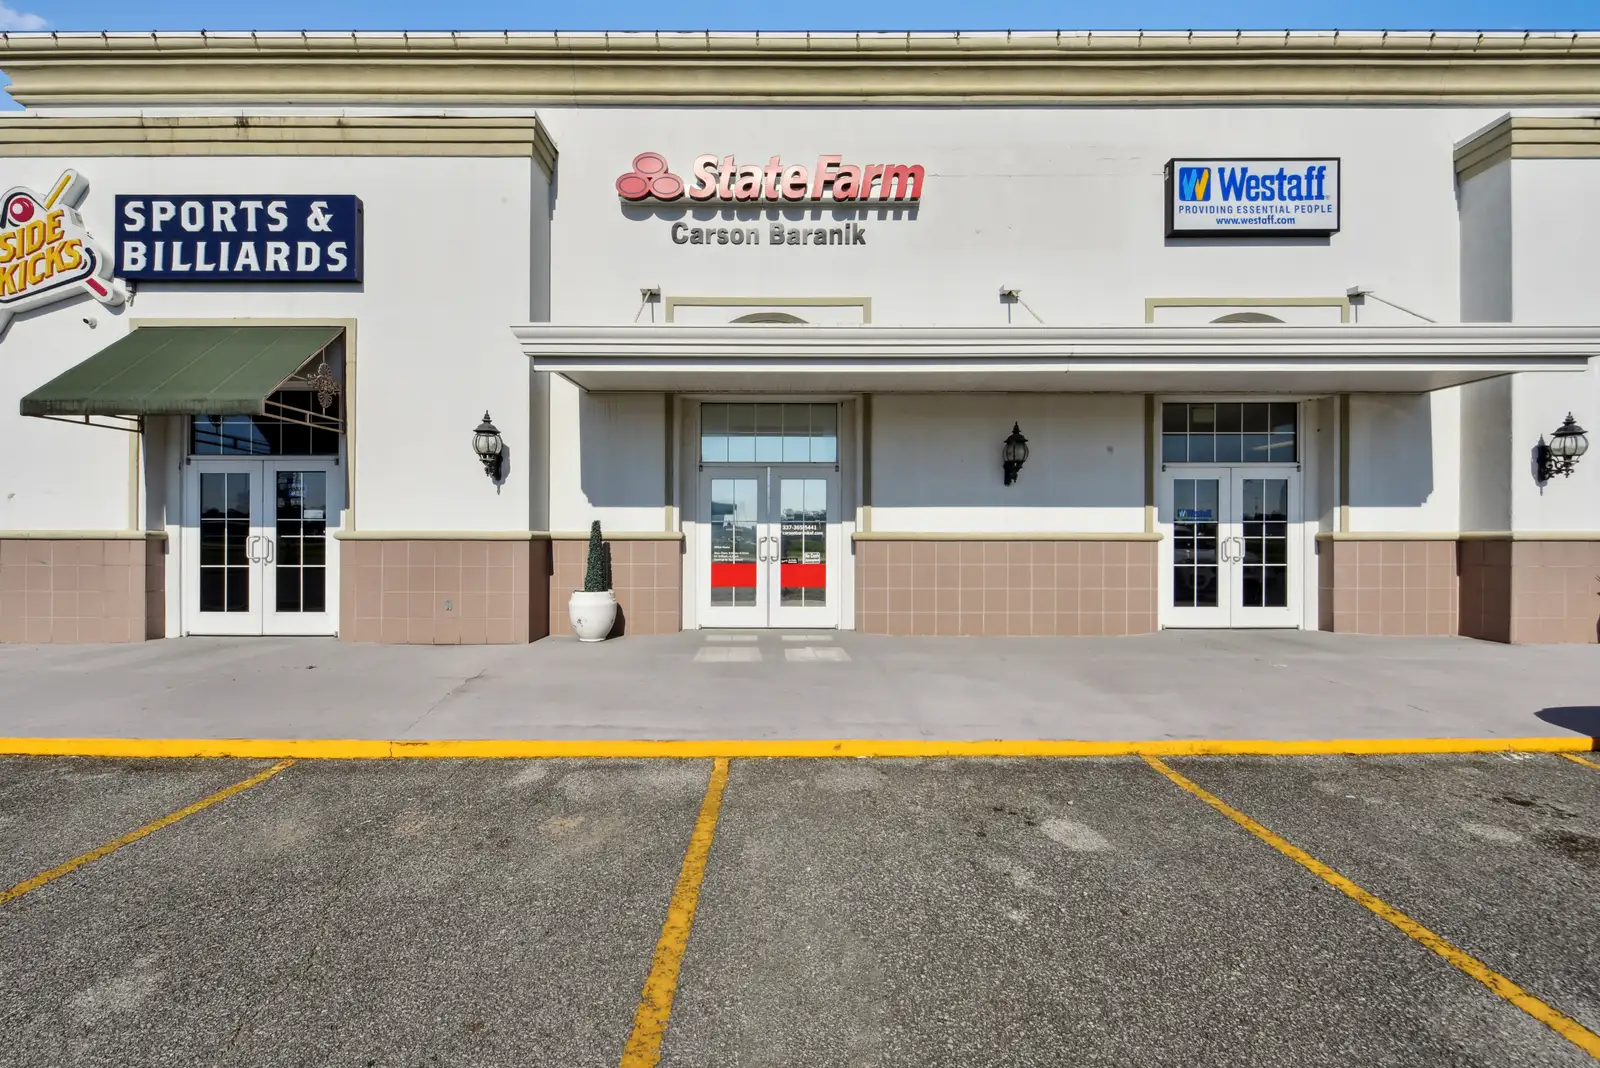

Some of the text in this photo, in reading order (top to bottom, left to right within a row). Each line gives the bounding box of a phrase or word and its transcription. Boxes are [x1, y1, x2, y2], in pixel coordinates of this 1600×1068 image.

[1217, 165, 1327, 202] Westaff
[123, 200, 333, 233] SPORTS &
[1178, 204, 1333, 214] PROVIDING ESSENTIAL PEOPLE
[1216, 214, 1296, 225] www.westaff.com
[0, 209, 66, 264] SIDE
[670, 222, 866, 246] Carson Baranik
[0, 238, 83, 298] KICKS
[122, 241, 348, 272] BILLIARDS
